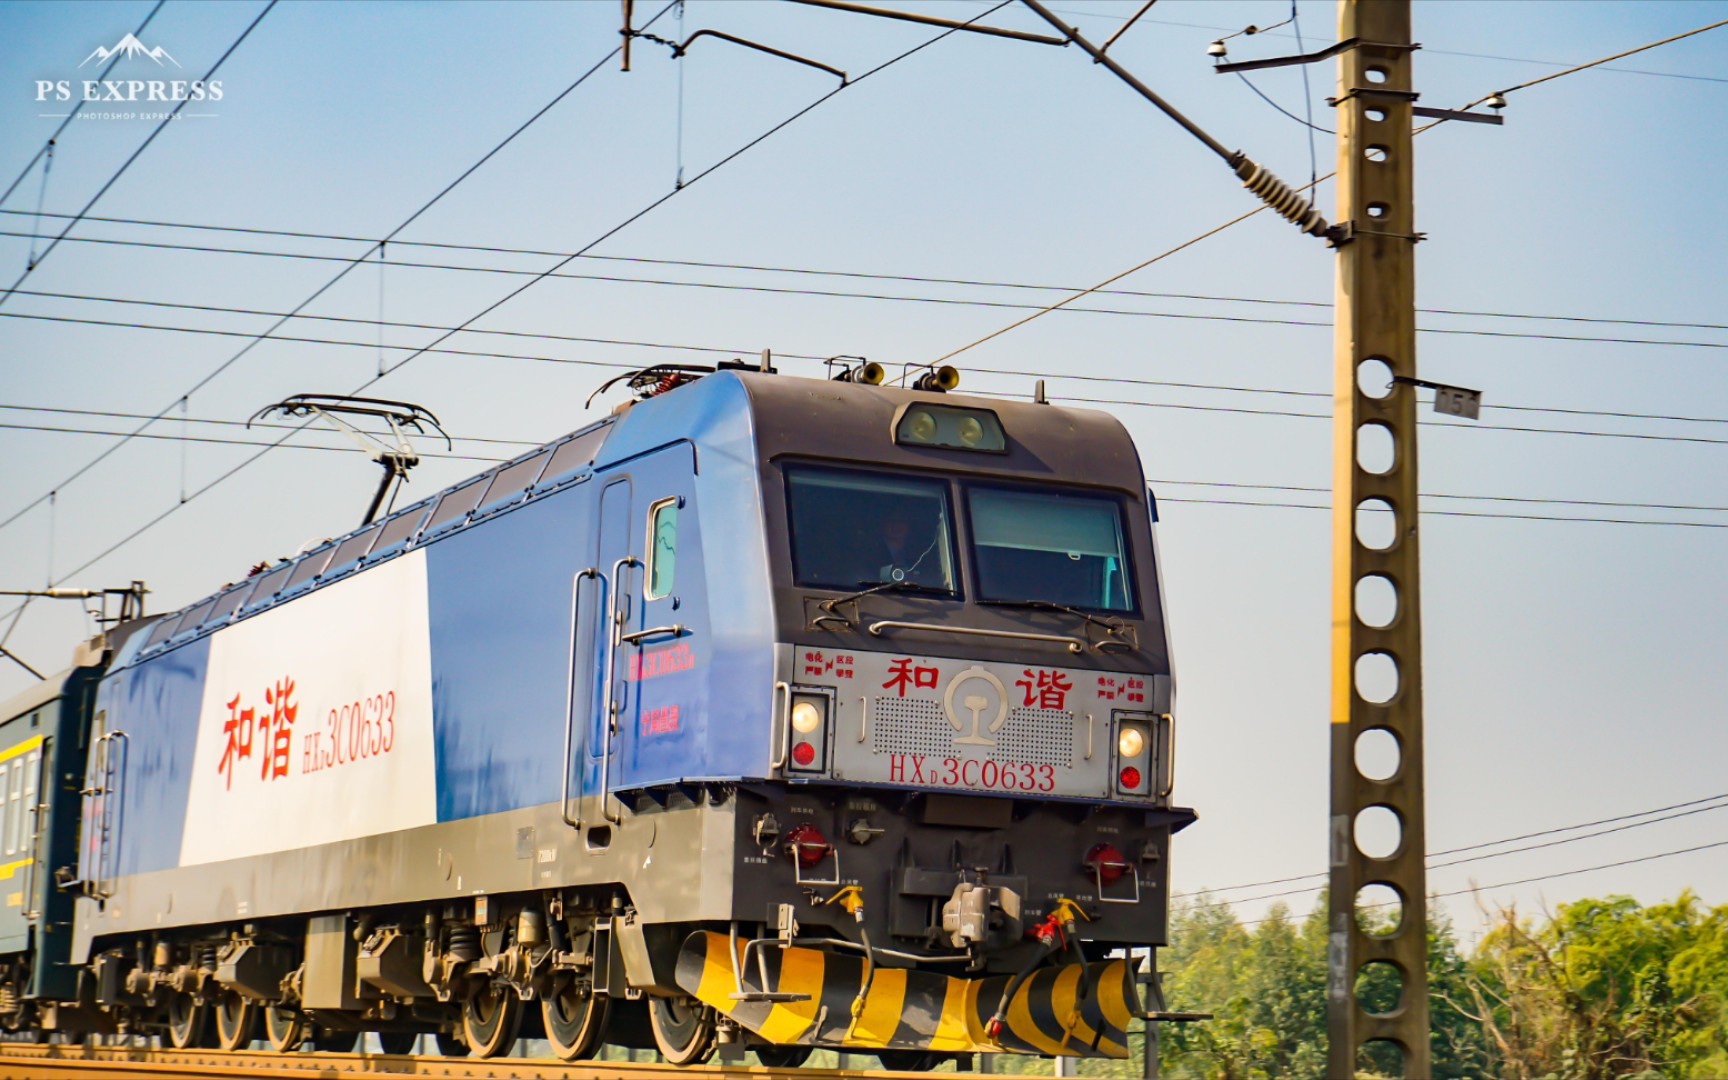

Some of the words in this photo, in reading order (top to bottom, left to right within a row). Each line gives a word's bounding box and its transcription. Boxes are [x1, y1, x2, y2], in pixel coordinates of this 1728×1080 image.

[883, 658, 940, 698] 和
[1015, 669, 1073, 711] 谐
[218, 675, 299, 791] 和谐
[889, 754, 1055, 792] HXD3C0633
